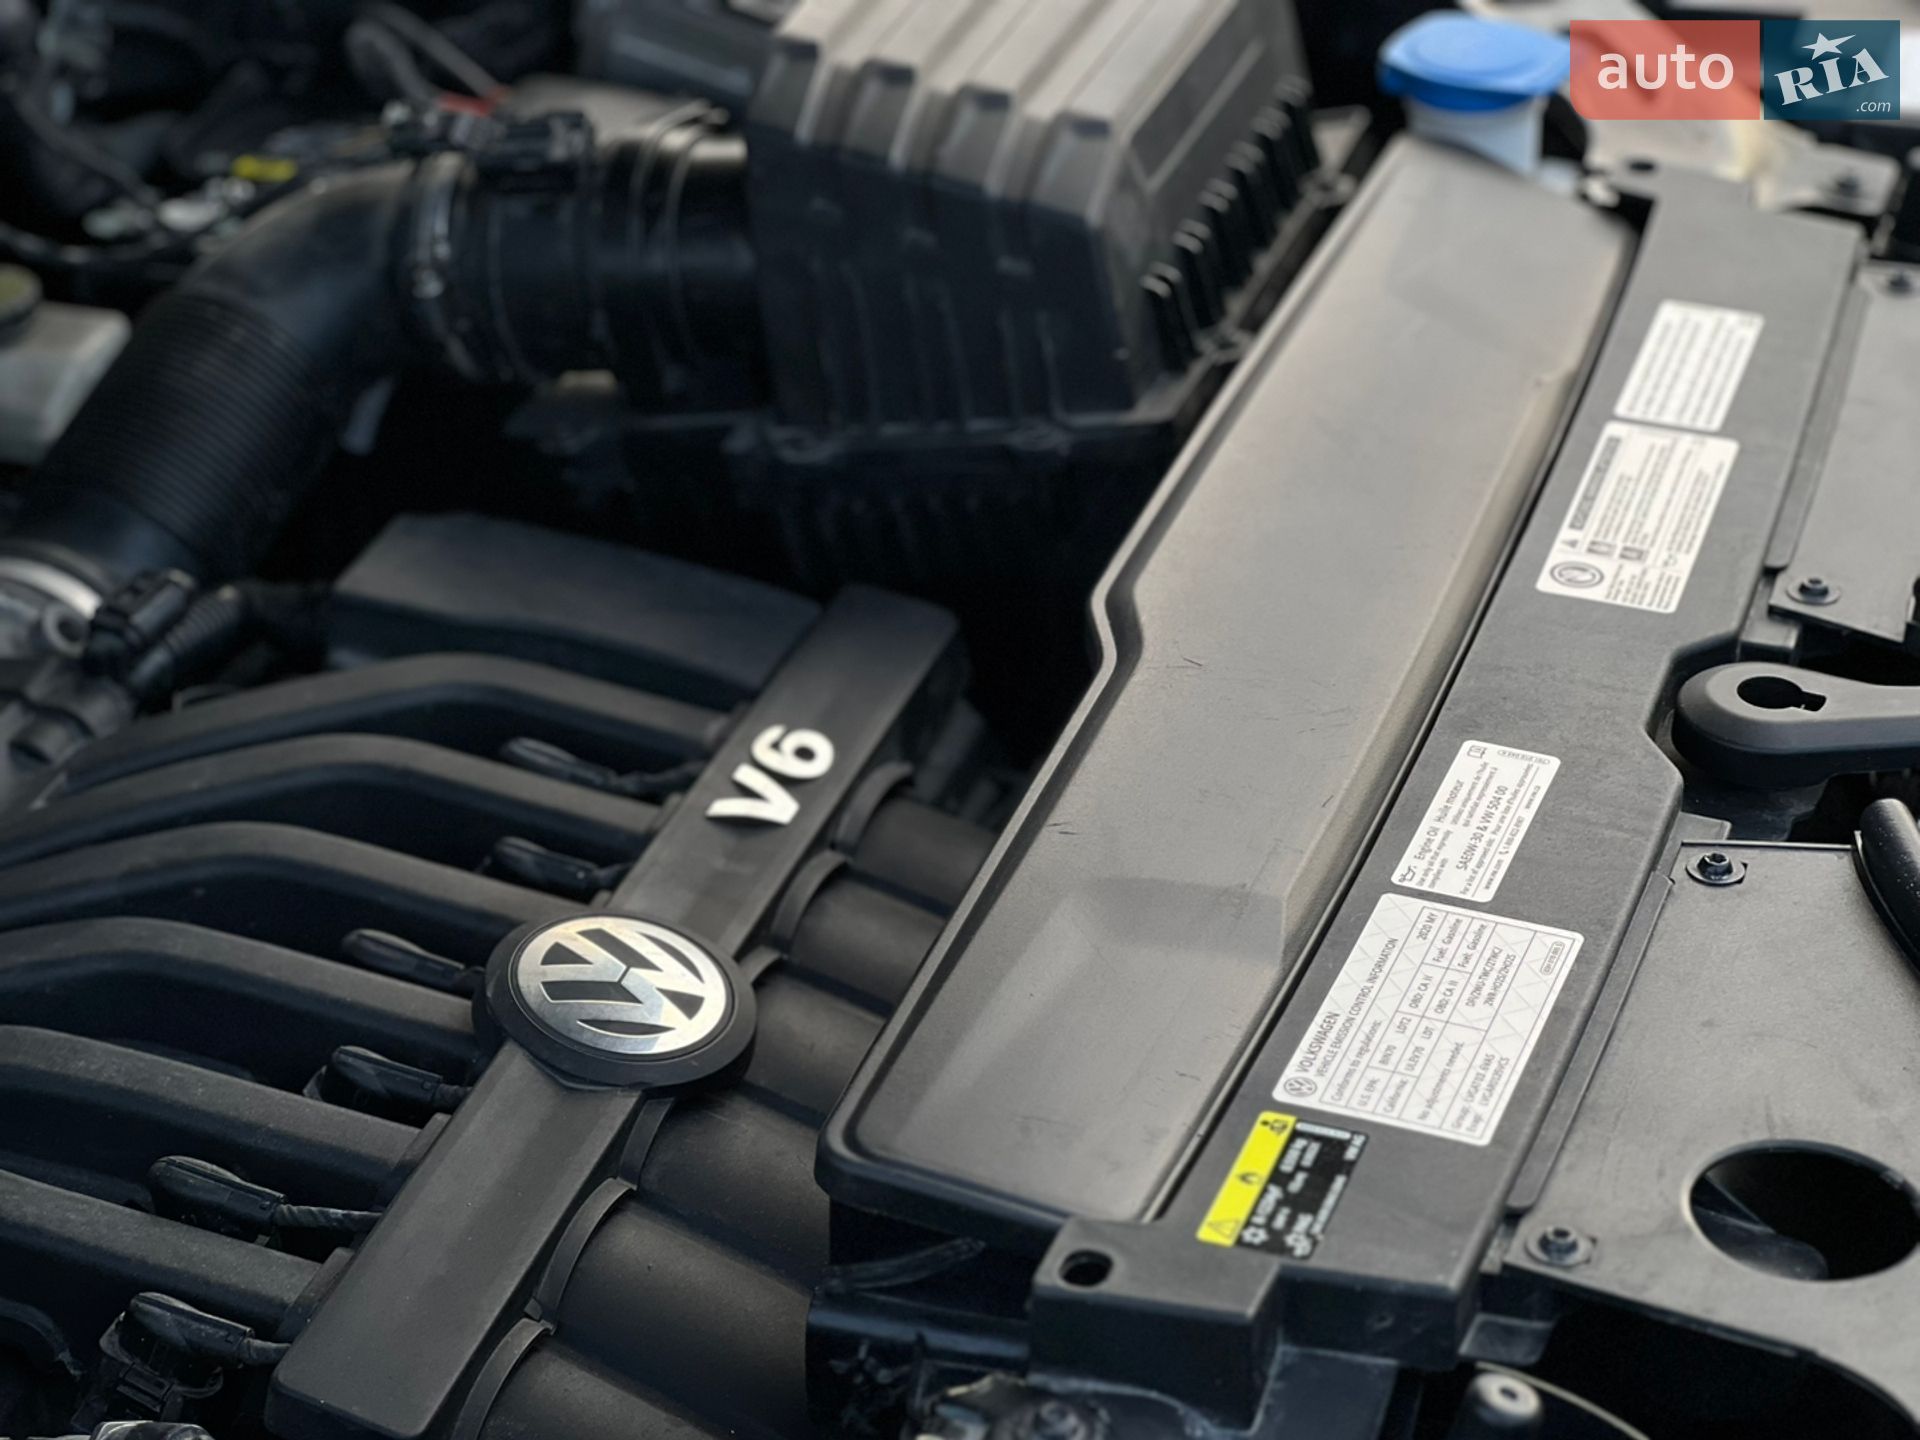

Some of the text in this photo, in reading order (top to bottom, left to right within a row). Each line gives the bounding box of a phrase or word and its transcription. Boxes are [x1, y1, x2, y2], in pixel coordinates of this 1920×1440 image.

[706, 724, 835, 825] V6
[1494, 785, 1508, 795] 00
[1434, 779, 1463, 822] Huile moteur
[1479, 809, 1494, 823] VW
[1486, 795, 1502, 810] 504
[1413, 826, 1439, 860] Engine Oil
[1416, 924, 1432, 940] 2020
[1432, 918, 1462, 962] Fuel: Gasoline
[1457, 923, 1487, 967] Fuel: Gasoline
[1417, 982, 1429, 991] CA
[1442, 987, 1454, 996] CA
[1316, 937, 1399, 1076] VEHICLE EMISSION CONTROL INFORMATION
[1395, 1016, 1411, 1034] LDT2
[1421, 1025, 1434, 1039] LDT
[1295, 1011, 1340, 1074] VOLKSWAGEN
[1330, 1020, 1382, 1101] Conforms to regulations:
[1417, 1110, 1429, 1120] No
[1425, 1067, 1451, 1109] adjustments
